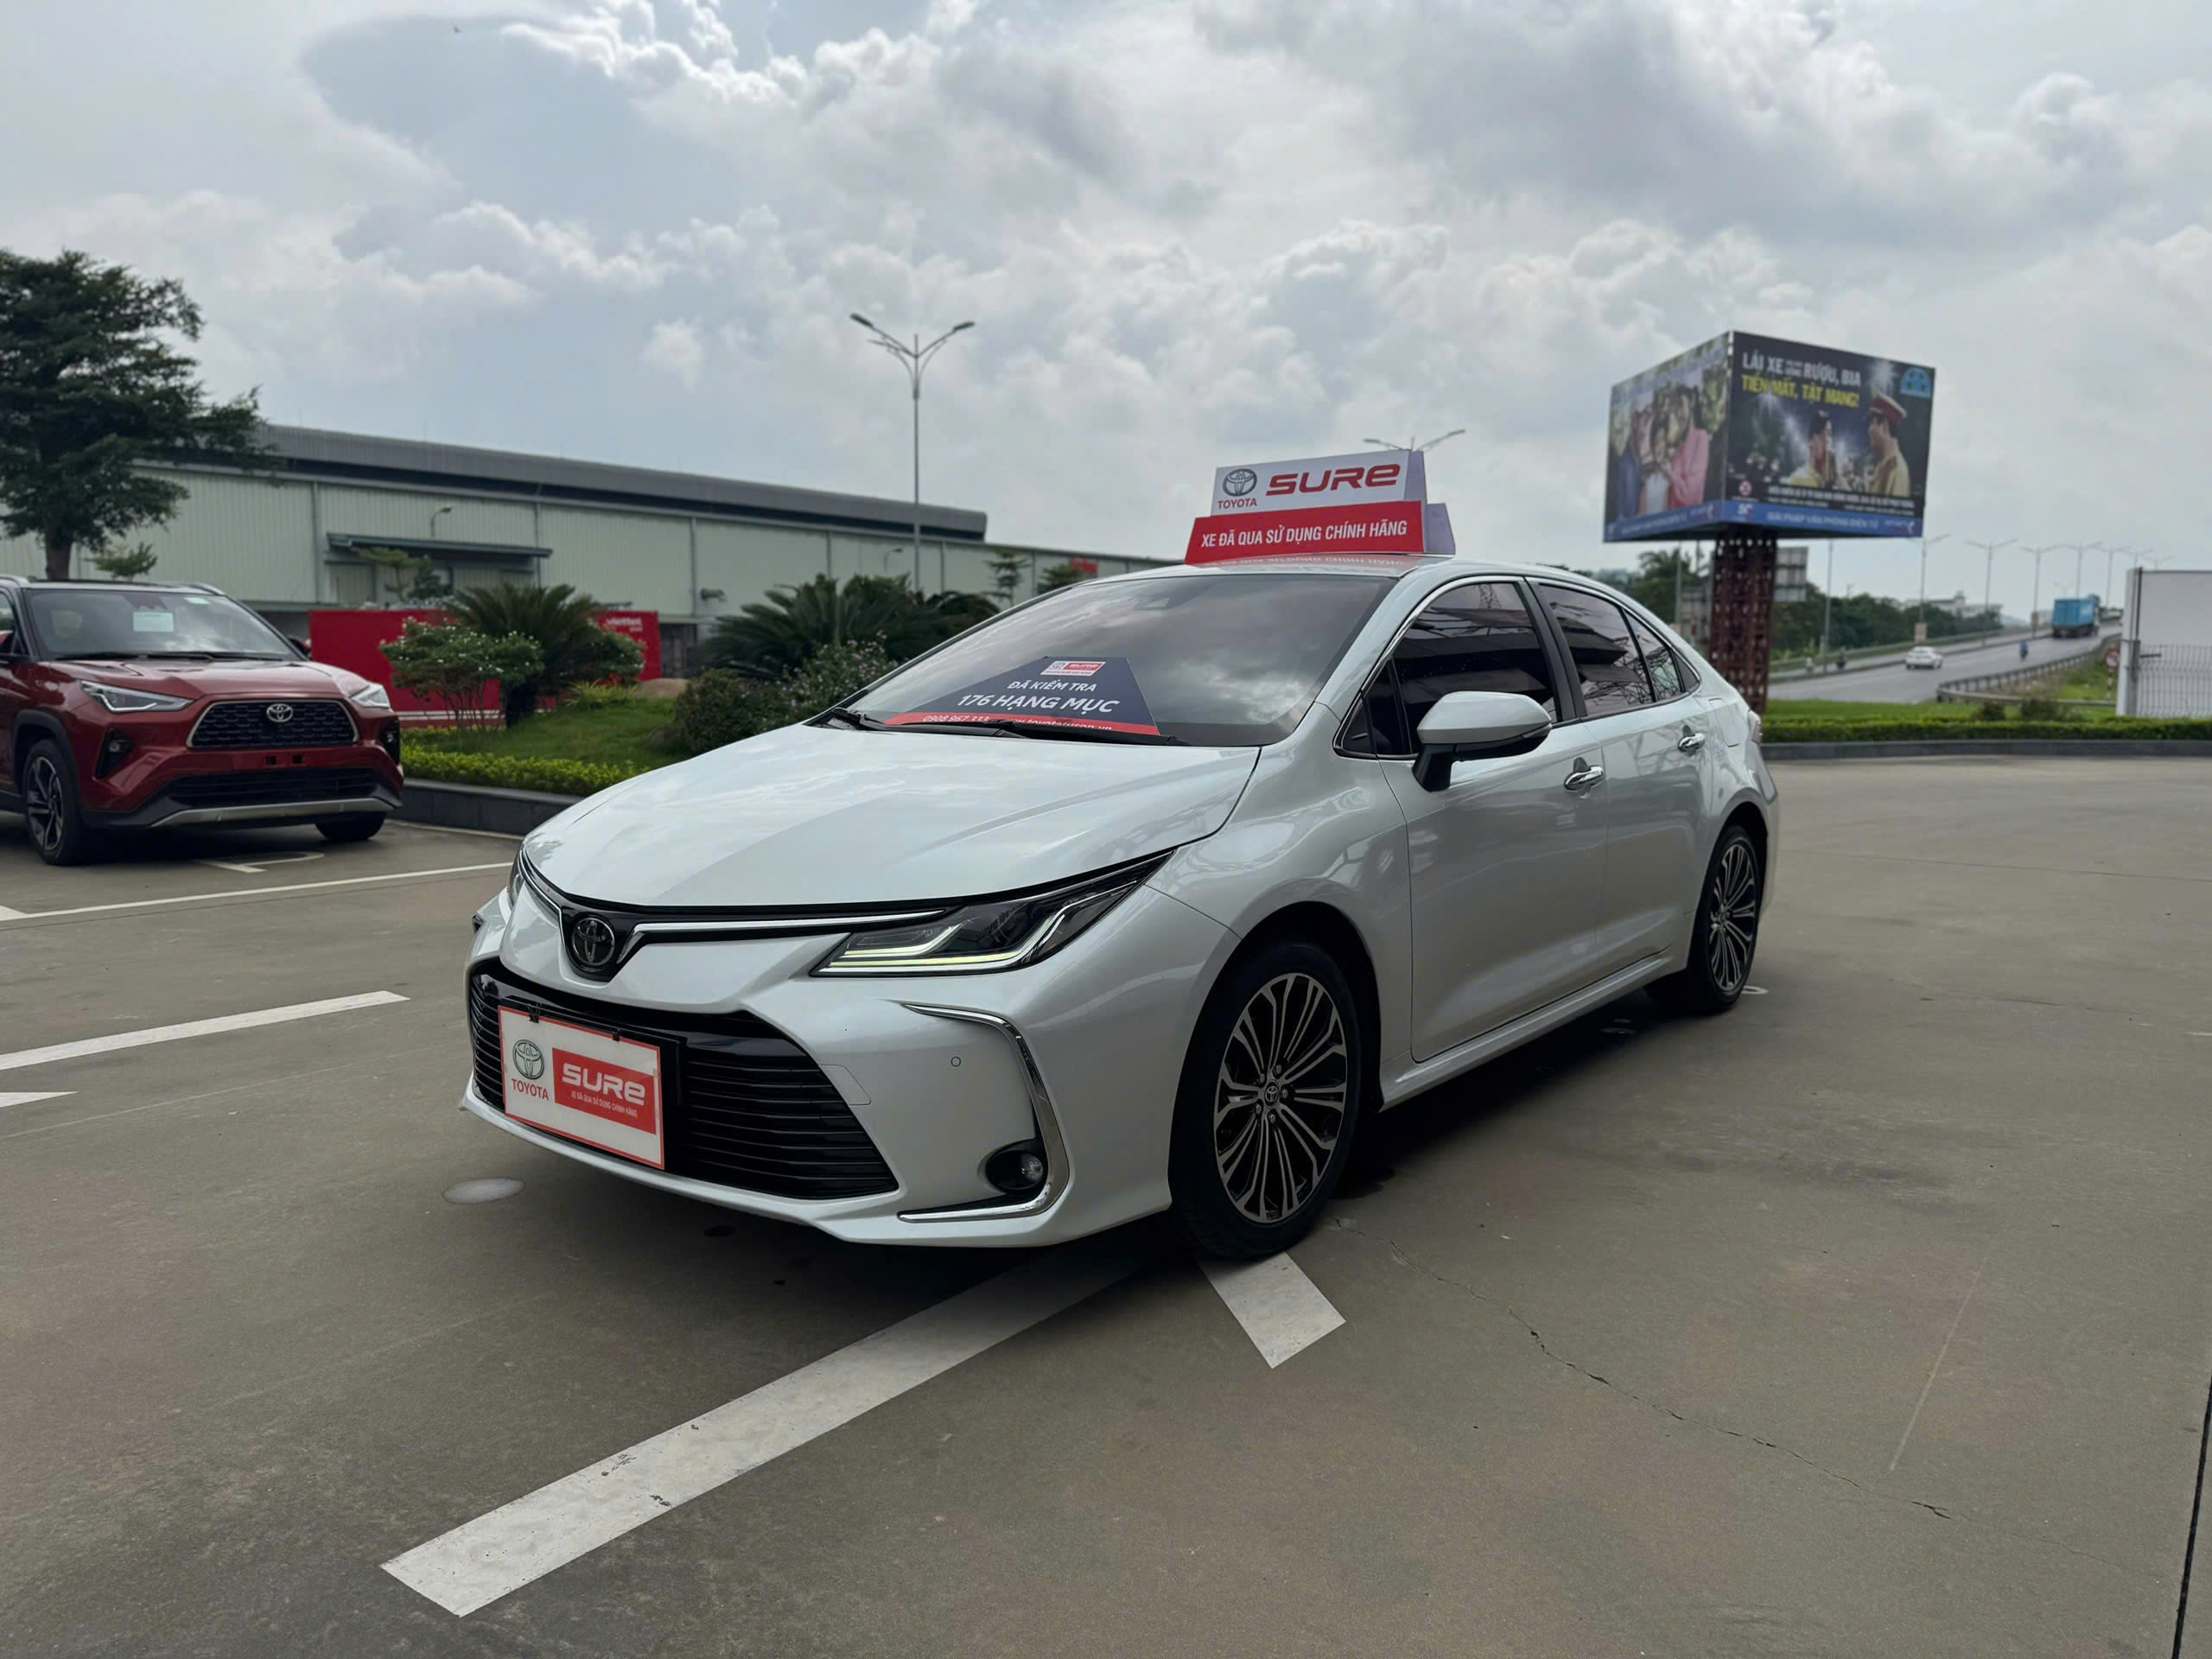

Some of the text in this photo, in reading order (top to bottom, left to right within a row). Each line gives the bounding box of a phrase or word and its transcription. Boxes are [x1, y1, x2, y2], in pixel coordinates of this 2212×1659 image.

[1767, 356, 1784, 374] XE
[1217, 498, 1258, 510] TOYOTA
[1201, 518, 1408, 548] XE ĐÃ QUA SỬ DỤNG CHÍNH HÃNG
[1007, 679, 1097, 692] ĐÃ KIỂM TRA
[957, 695, 1121, 715] 176 HẠNG MỤC
[512, 1078, 550, 1101] TOYOTA
